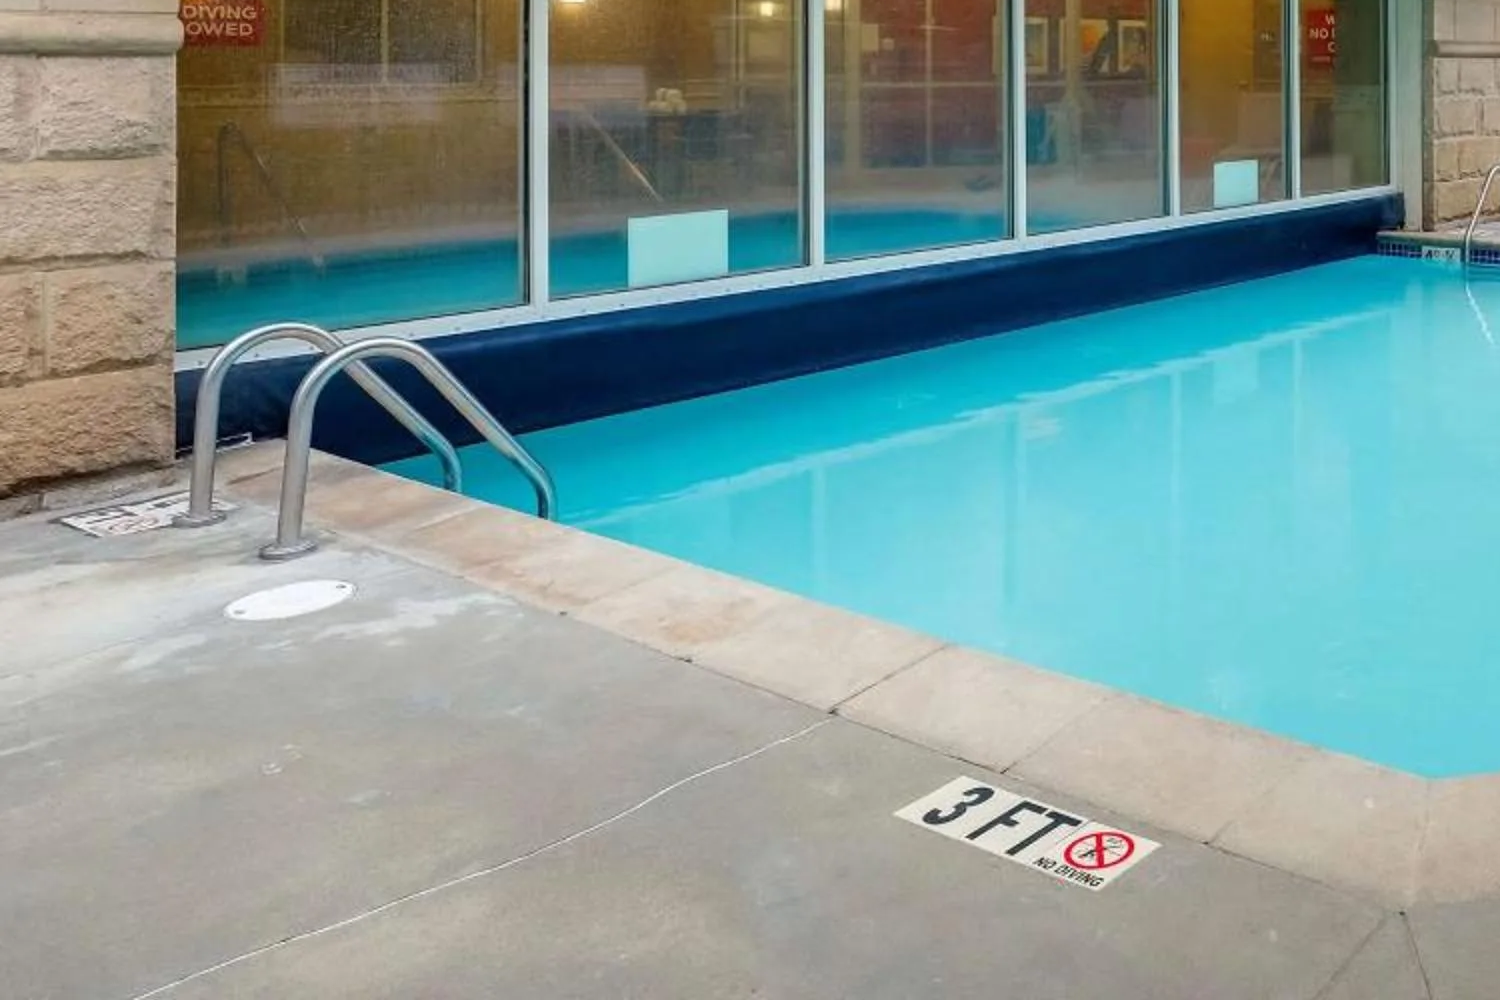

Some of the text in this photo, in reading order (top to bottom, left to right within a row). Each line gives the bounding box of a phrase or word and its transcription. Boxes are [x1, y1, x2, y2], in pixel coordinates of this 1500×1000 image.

[183, 5, 257, 19] DIVING
[186, 21, 254, 37] OWED
[923, 787, 1083, 856] 3 FT
[1033, 857, 1104, 887] NO DIVING
